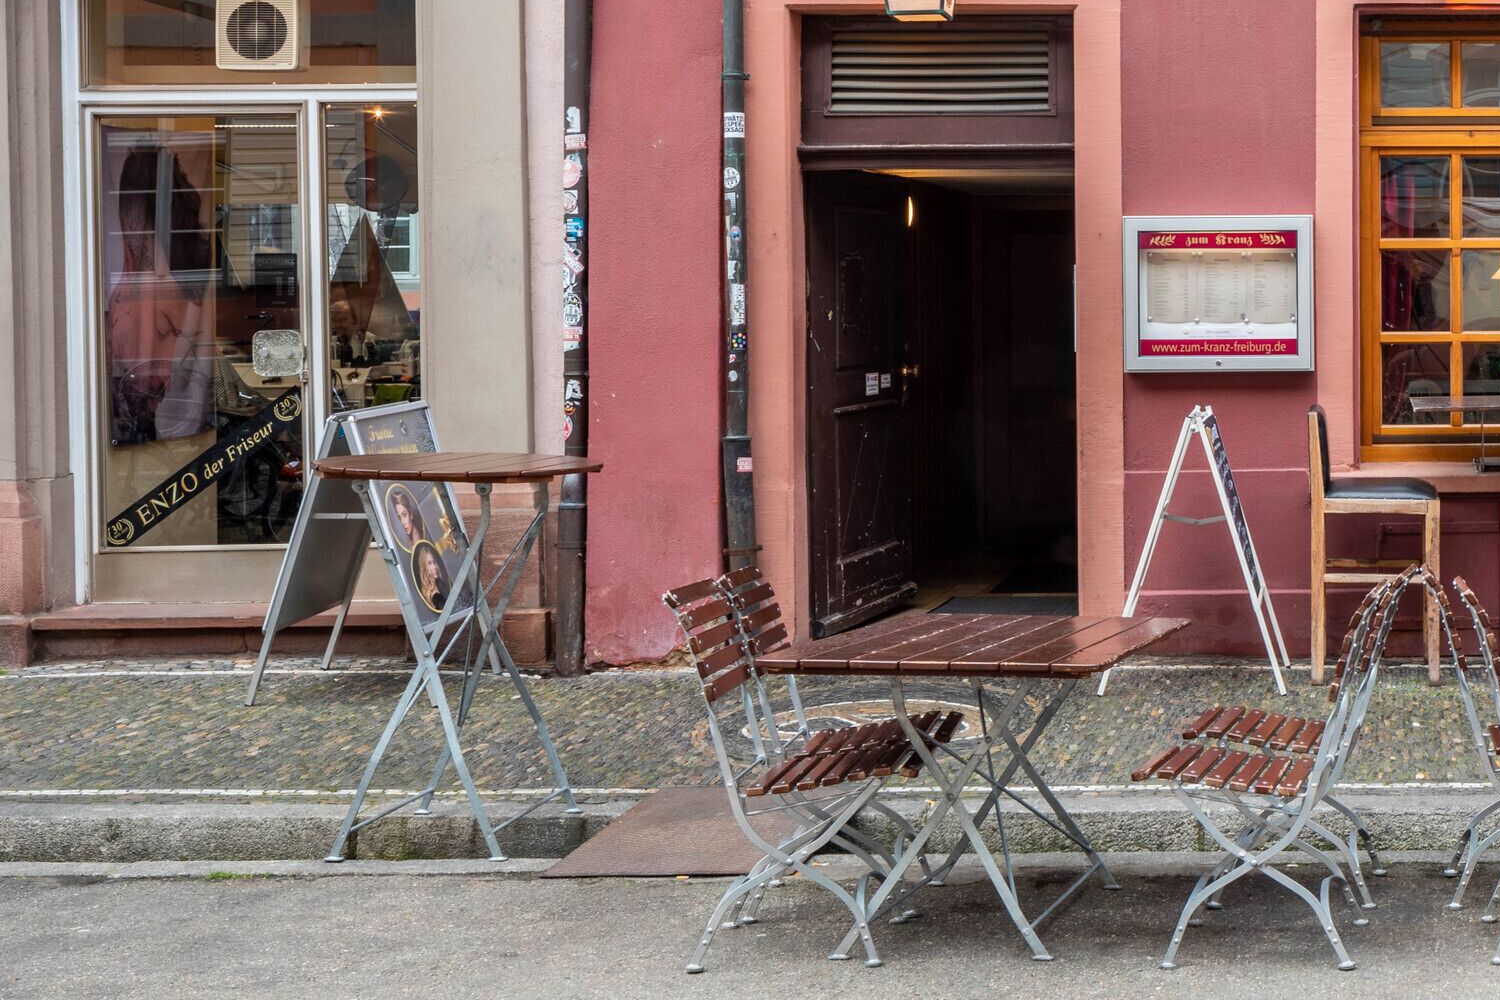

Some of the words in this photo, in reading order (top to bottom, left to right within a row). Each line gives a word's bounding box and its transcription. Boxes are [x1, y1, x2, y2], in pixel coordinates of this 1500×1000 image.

[1185, 236, 1209, 247] zum
[1215, 234, 1253, 247] Kranz
[1152, 341, 1287, 354] www.zum-kranz-freiburg.de
[279, 398, 290, 411] 30
[135, 472, 199, 527] ENZO
[203, 458, 224, 480] der
[226, 421, 274, 464] Friseur
[111, 522, 123, 534] 30
